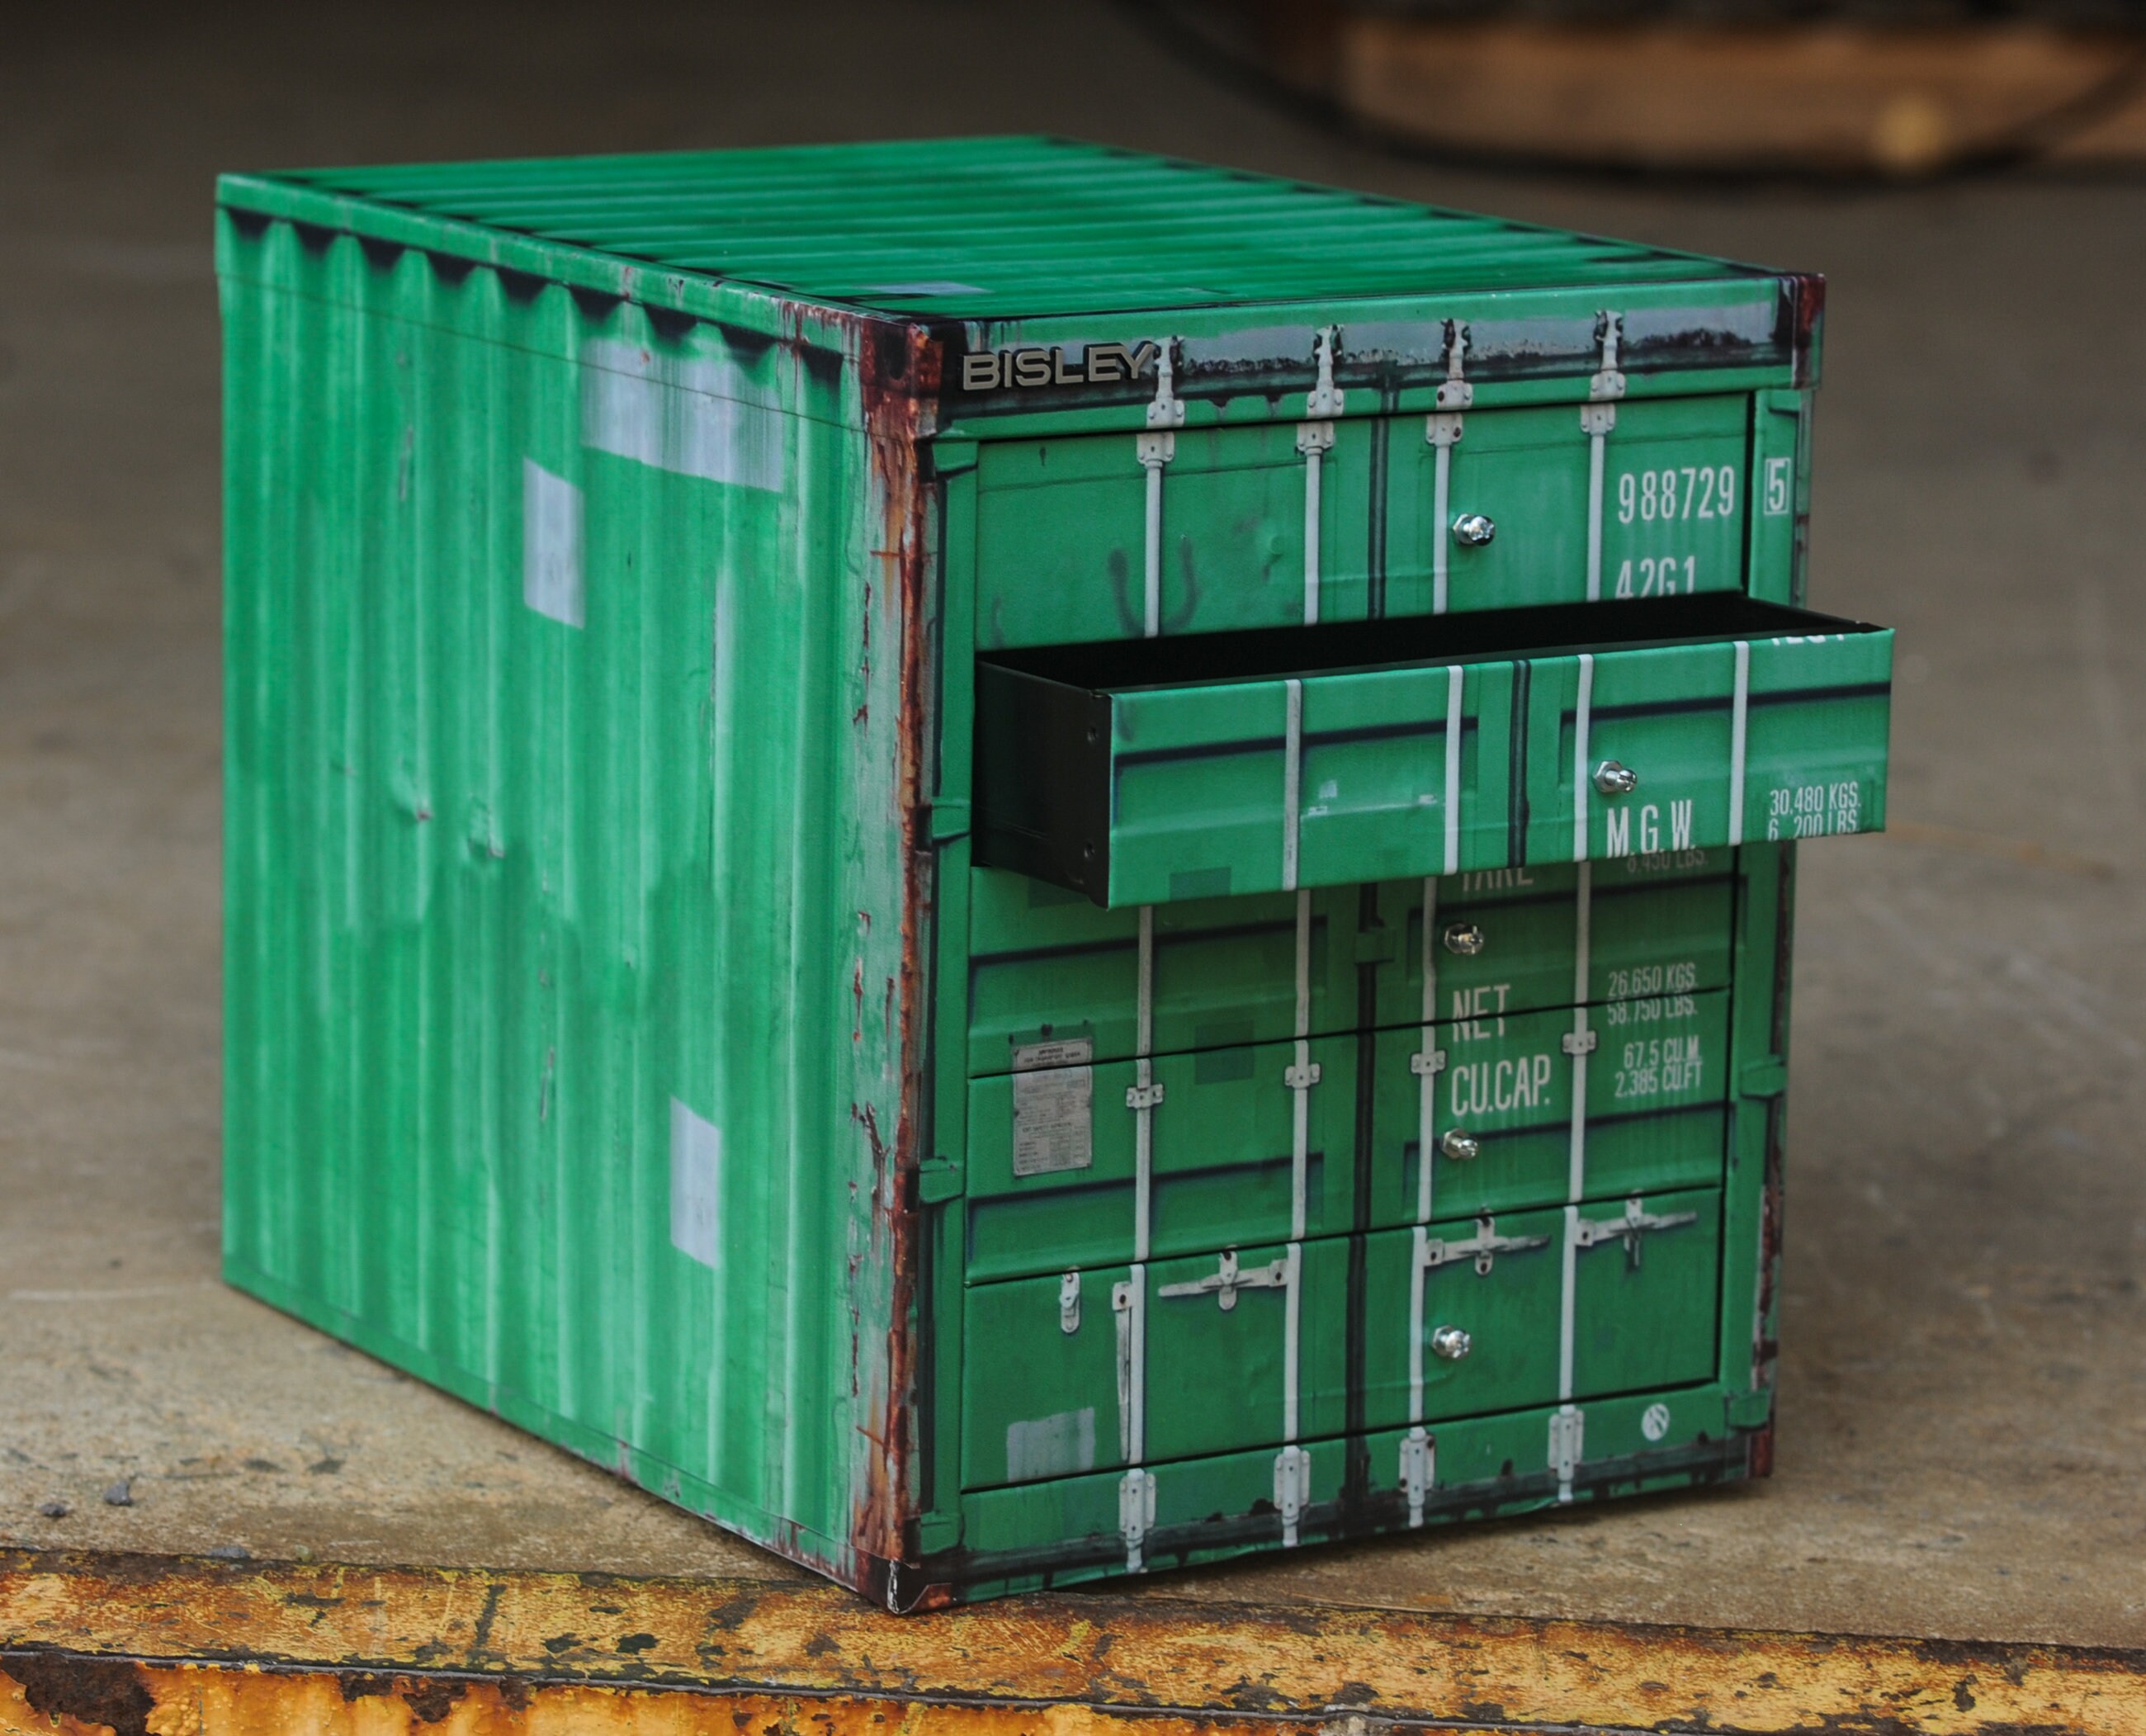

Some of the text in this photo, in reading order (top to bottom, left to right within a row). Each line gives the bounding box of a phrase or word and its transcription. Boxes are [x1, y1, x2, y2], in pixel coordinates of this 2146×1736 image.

[962, 341, 1156, 390] BISLEY
[1619, 466, 1734, 523] 988729
[1767, 458, 1787, 512] 5
[1615, 556, 1695, 599] 42G1
[1770, 781, 1861, 816] 30.480 KGS.
[1608, 963, 1699, 997] 26.650 KGS.
[1453, 983, 1510, 1043] NET
[1624, 1040, 1659, 1069] 67.5
[1615, 1068, 1658, 1098] 2.385
